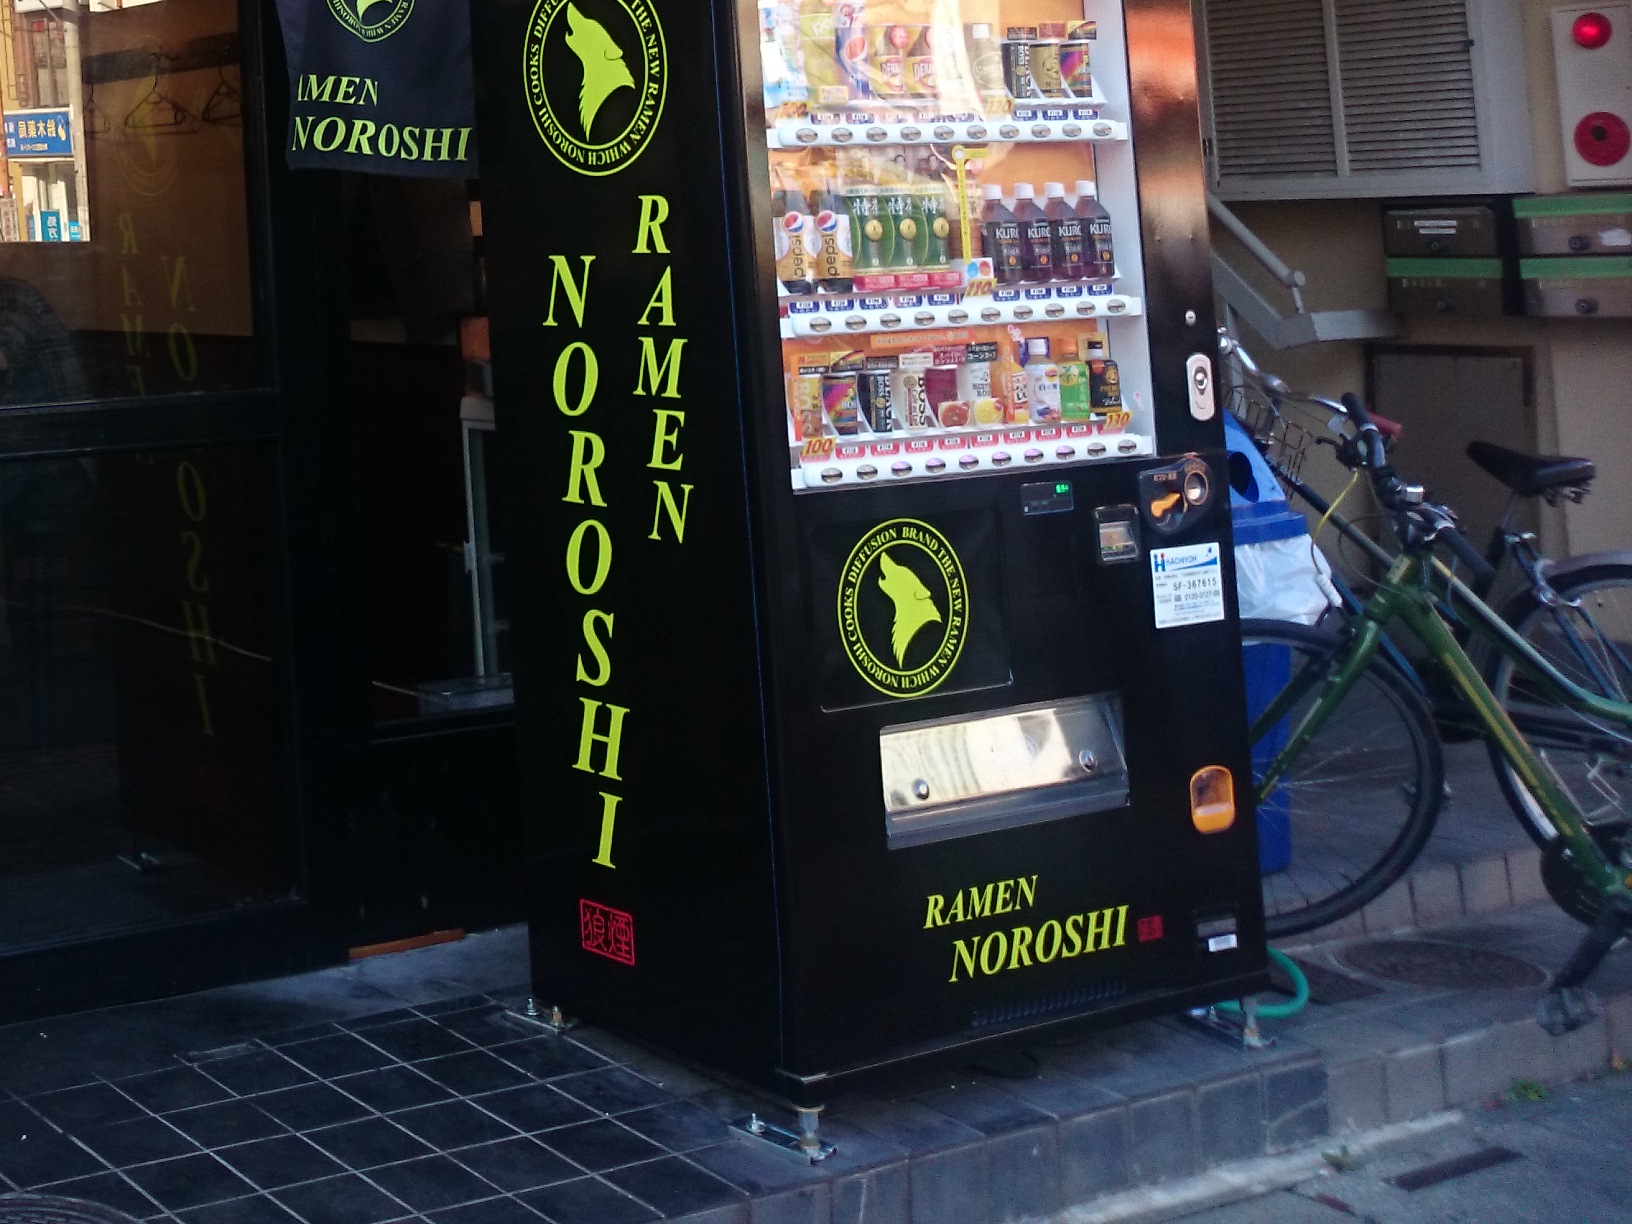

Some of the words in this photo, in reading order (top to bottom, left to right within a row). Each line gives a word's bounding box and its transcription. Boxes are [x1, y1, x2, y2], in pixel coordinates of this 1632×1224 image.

[529, 43, 542, 106] COOKS
[645, 33, 660, 76] NEW
[538, 107, 585, 163] NOROSHI
[630, 82, 659, 144] RAMEN
[292, 116, 472, 161] NOROSHI
[588, 143, 631, 165] WHICH
[789, 234, 806, 278] pepsi
[824, 234, 840, 276] pepsi
[632, 194, 694, 544] RAMEN
[806, 438, 833, 455] 100
[543, 255, 630, 869] NOROSHI
[847, 528, 897, 583] DIFFUSION
[902, 526, 939, 552] BRAND
[937, 547, 953, 577] THE
[843, 587, 856, 642] COOKS
[951, 578, 963, 613] NEW
[852, 640, 898, 688] NOROSHI
[938, 616, 962, 668] RAMEN
[901, 666, 940, 689] WHICH
[923, 875, 1038, 929] RAMEN
[949, 905, 1129, 983] NOROSHI
